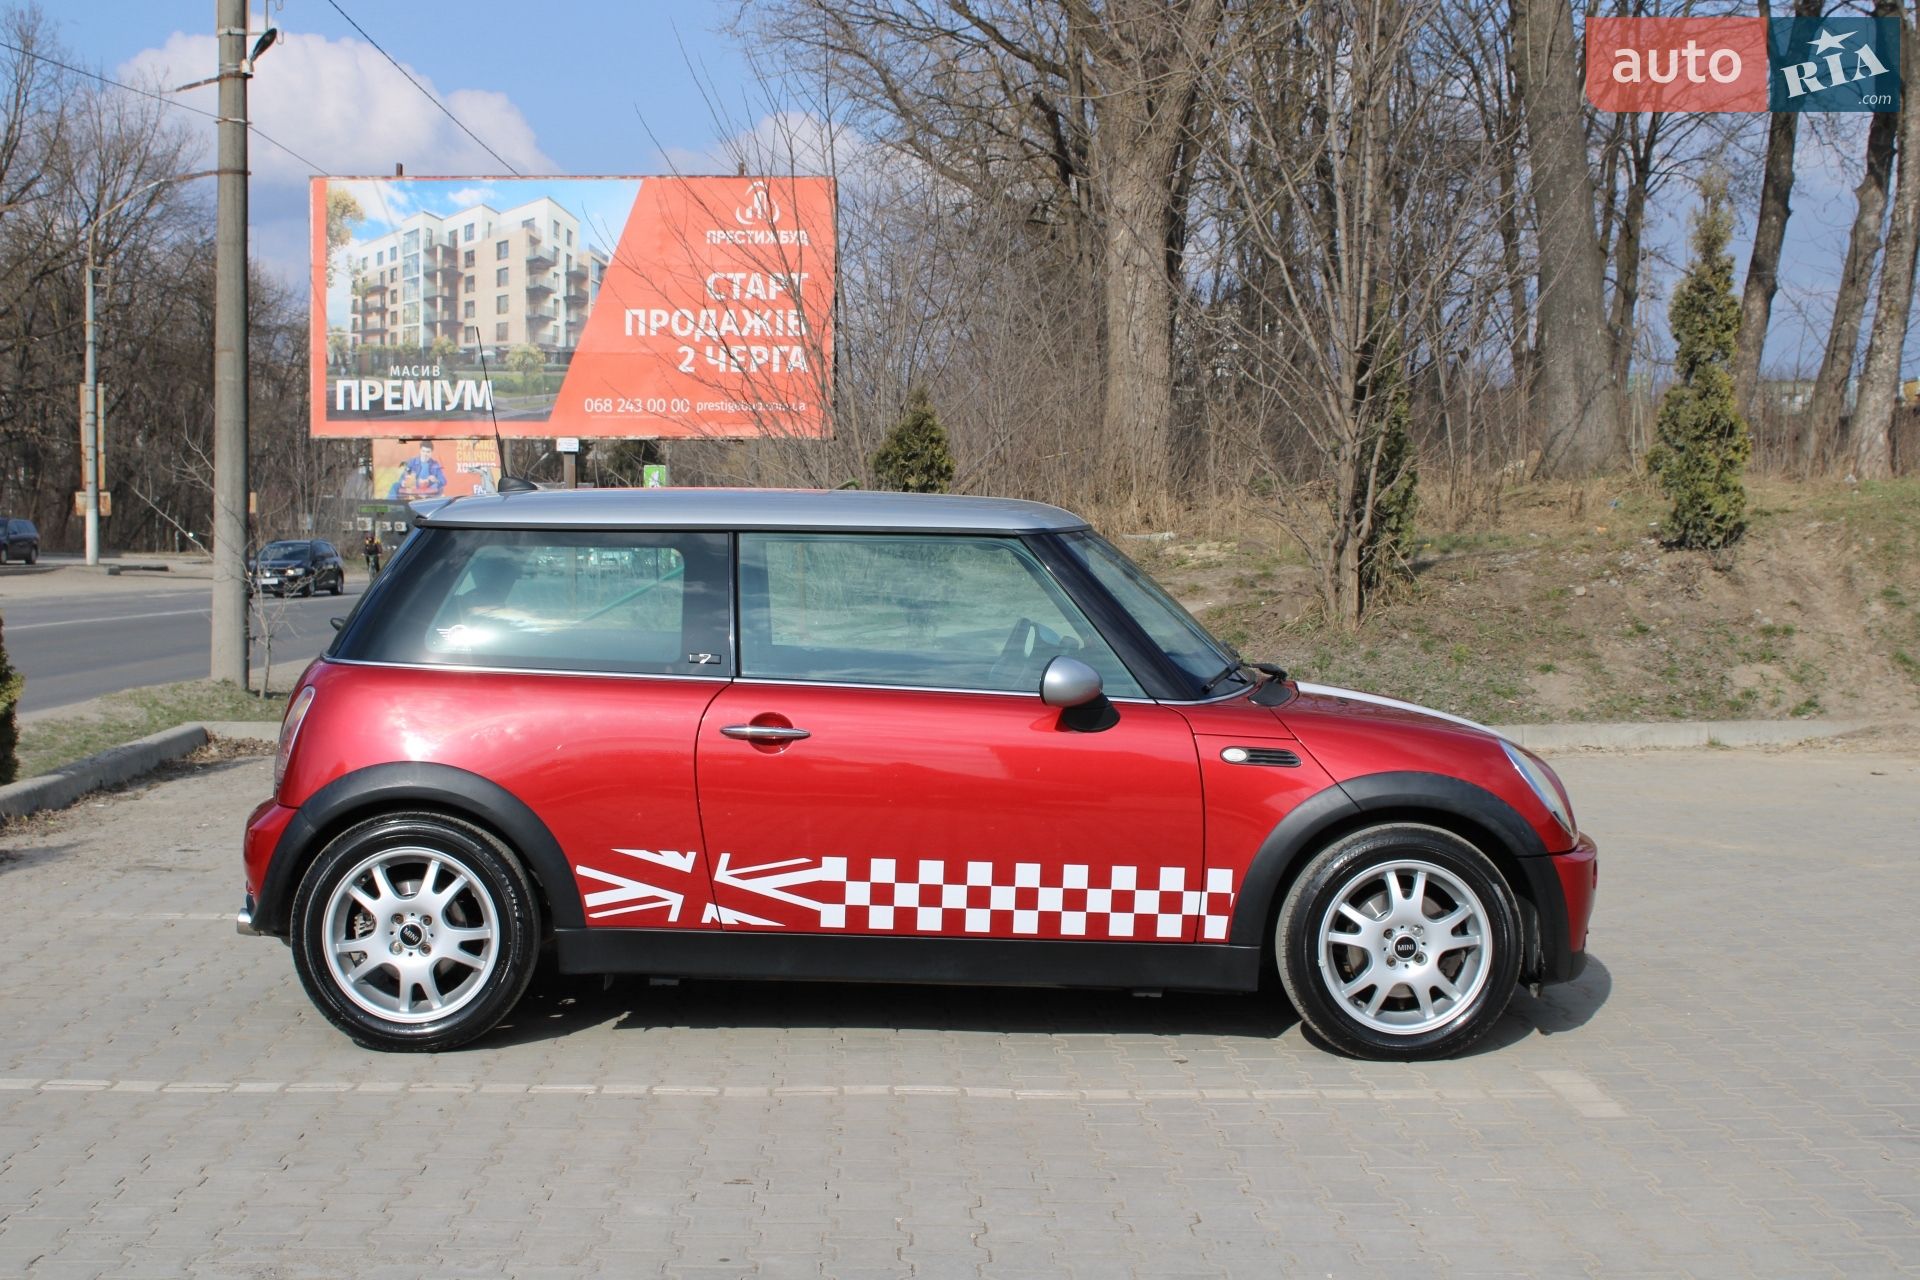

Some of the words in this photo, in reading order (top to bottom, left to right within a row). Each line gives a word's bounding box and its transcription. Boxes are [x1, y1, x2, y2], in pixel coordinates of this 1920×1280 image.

[706, 229, 809, 247] ПРЕСТИЖБУД
[706, 272, 809, 301] СТАРТ
[624, 308, 807, 342] ПРОДАЖІВ
[389, 365, 441, 377] МАСИВ
[677, 345, 696, 374] 2
[705, 345, 809, 374] ЧЕРГА
[336, 379, 493, 411] ПРЕМІУМ
[584, 398, 613, 413] 068
[616, 398, 642, 413] 243
[646, 398, 667, 413] 00
[670, 398, 691, 413] 00
[402, 927, 419, 942] MINI
